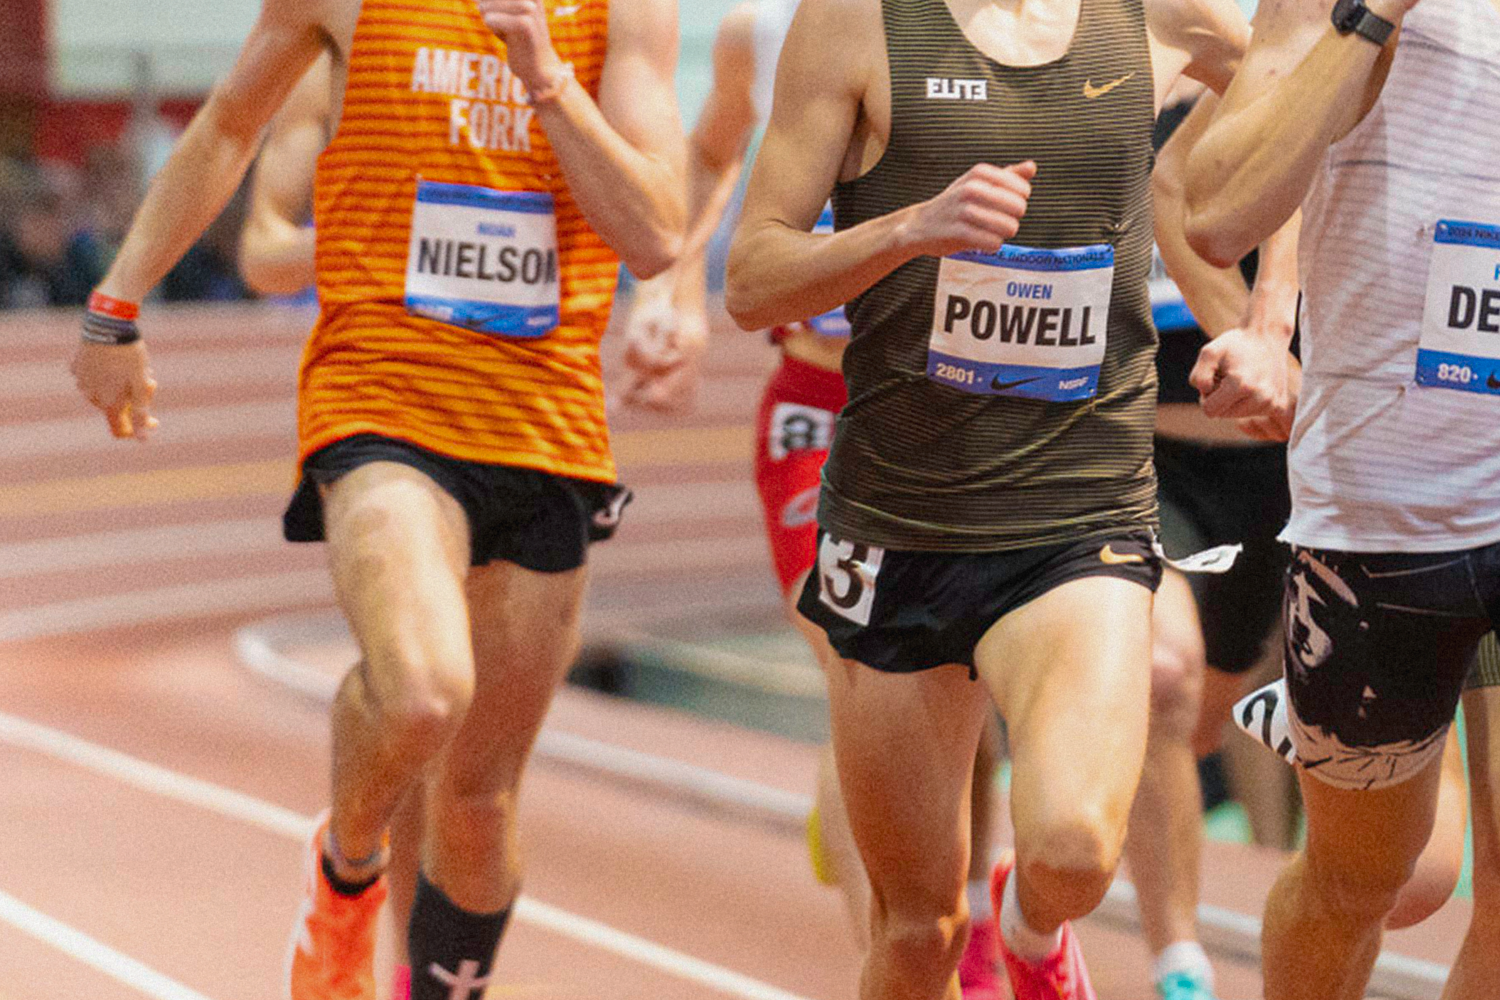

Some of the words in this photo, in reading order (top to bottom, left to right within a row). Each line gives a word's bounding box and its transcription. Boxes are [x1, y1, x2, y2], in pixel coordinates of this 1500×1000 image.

[412, 46, 532, 105] AMERI
[926, 77, 988, 101] ELITE
[449, 98, 534, 152] FORK
[1006, 281, 1053, 300] OWEN
[944, 294, 1096, 347] POWELL
[936, 362, 975, 385] 2801
[1437, 362, 1472, 384] 820
[824, 536, 869, 610] 3
